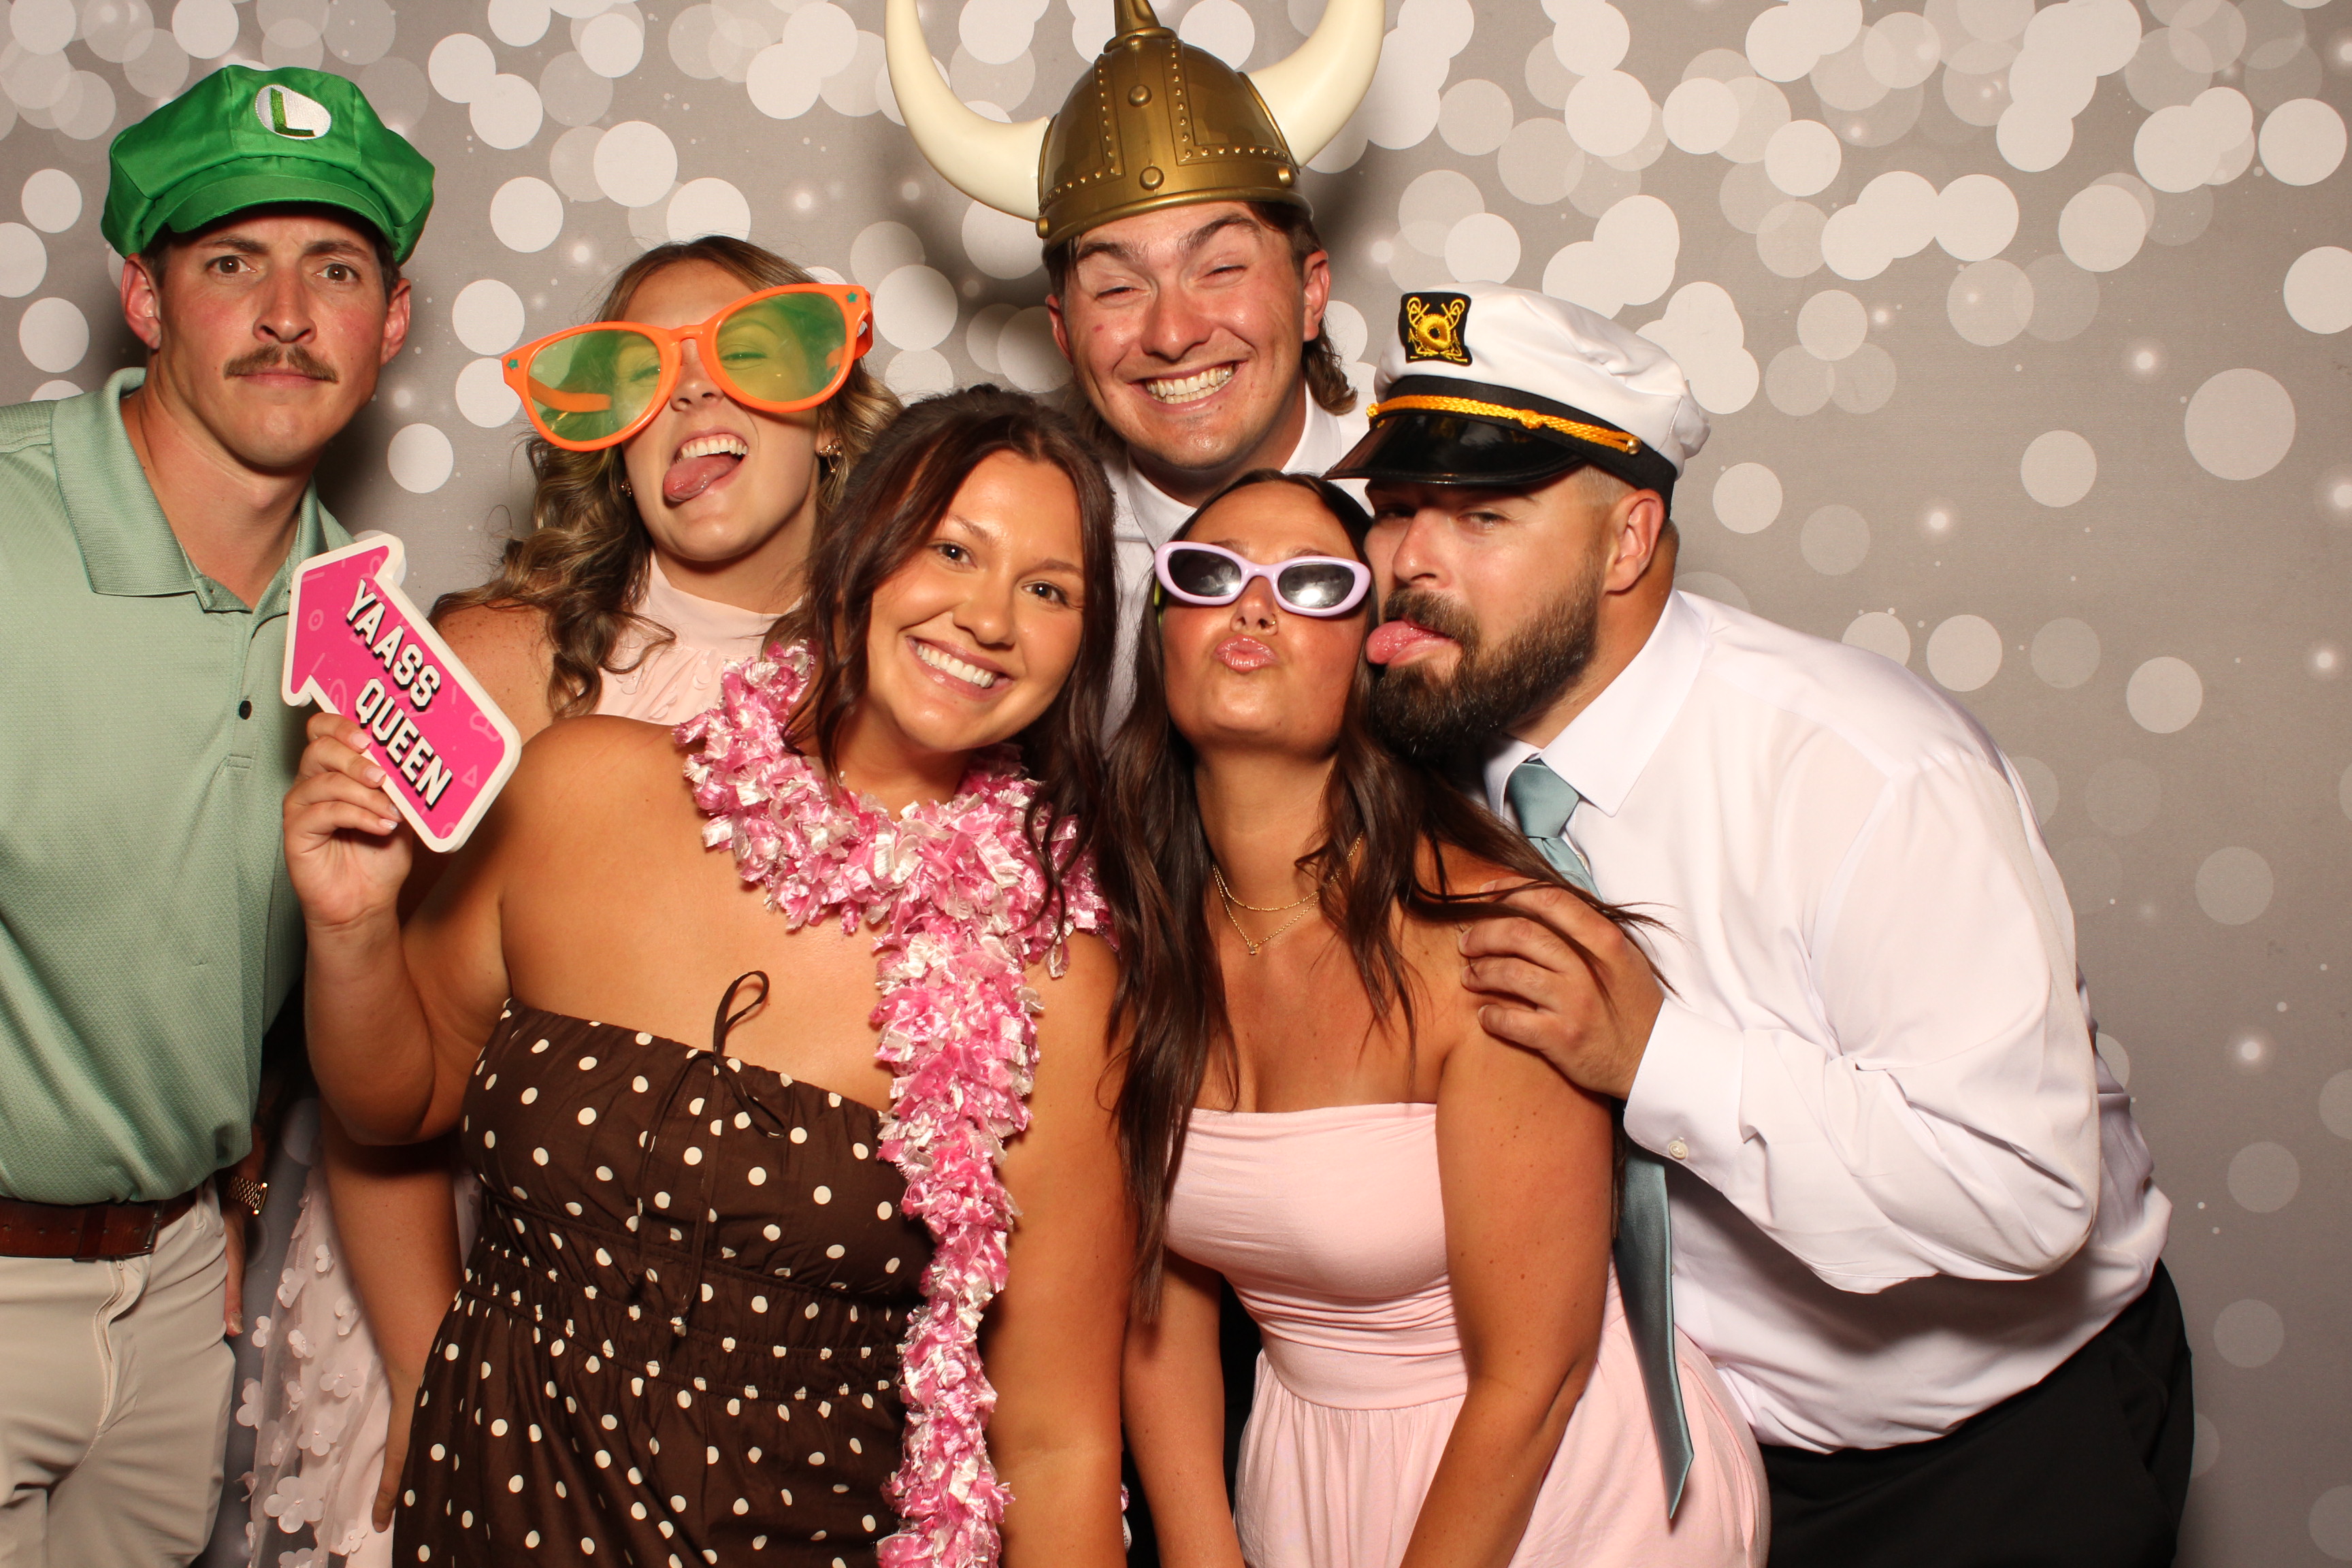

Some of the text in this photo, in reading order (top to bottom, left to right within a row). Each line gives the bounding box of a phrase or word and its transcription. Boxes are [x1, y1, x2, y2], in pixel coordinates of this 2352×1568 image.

[270, 87, 316, 137] L
[346, 578, 441, 708] YAASS
[355, 678, 453, 808] QUEEN
